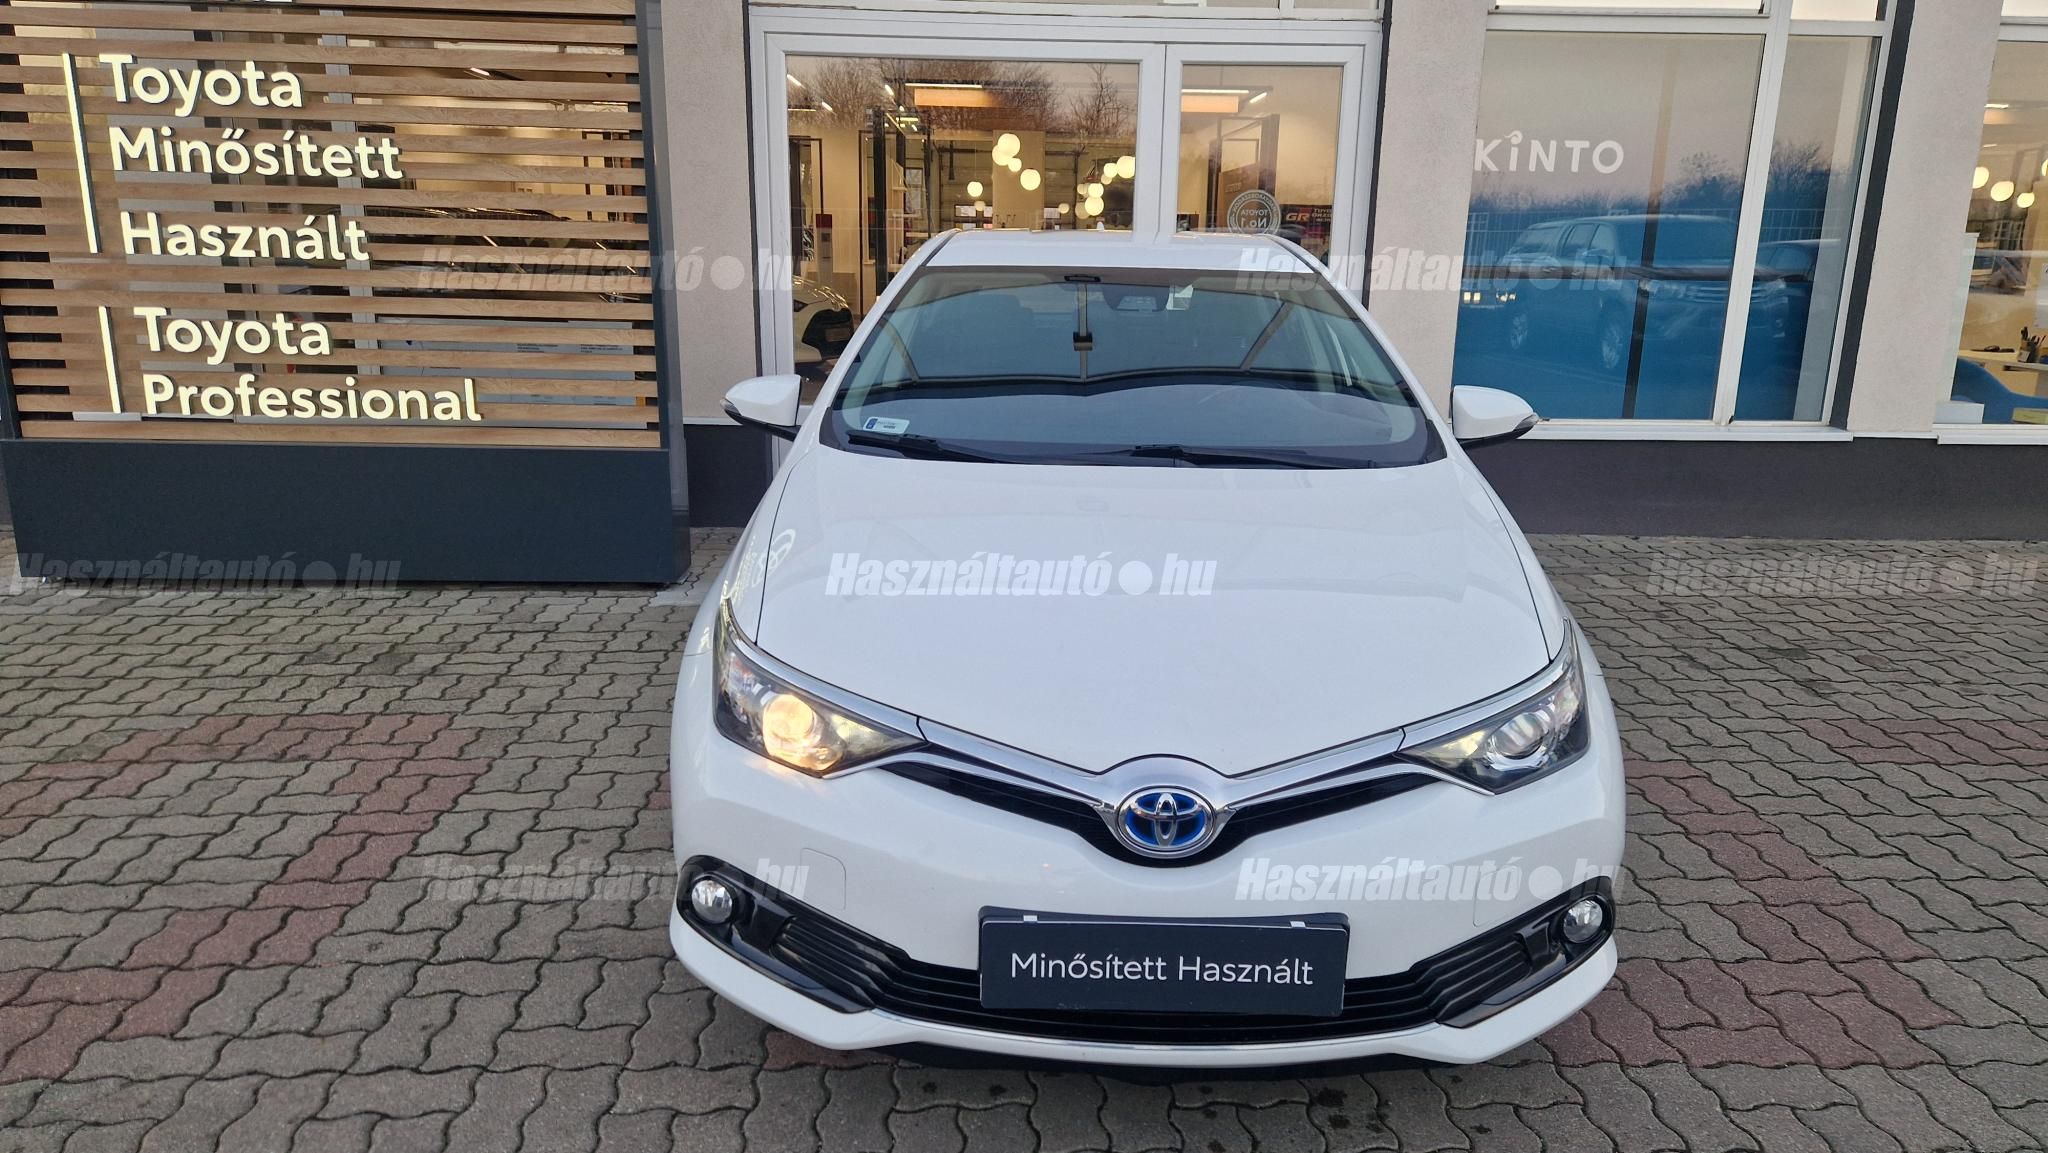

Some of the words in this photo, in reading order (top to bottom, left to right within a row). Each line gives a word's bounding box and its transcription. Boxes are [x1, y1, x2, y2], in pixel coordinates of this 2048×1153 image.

[99, 53, 302, 117] Toyota
[109, 127, 403, 179] Minősített
[120, 212, 370, 261] Használt
[134, 307, 331, 364] Toyota
[143, 374, 483, 422] Professional
[1011, 952, 1167, 981] Minősített
[1178, 956, 1314, 985] Használt
